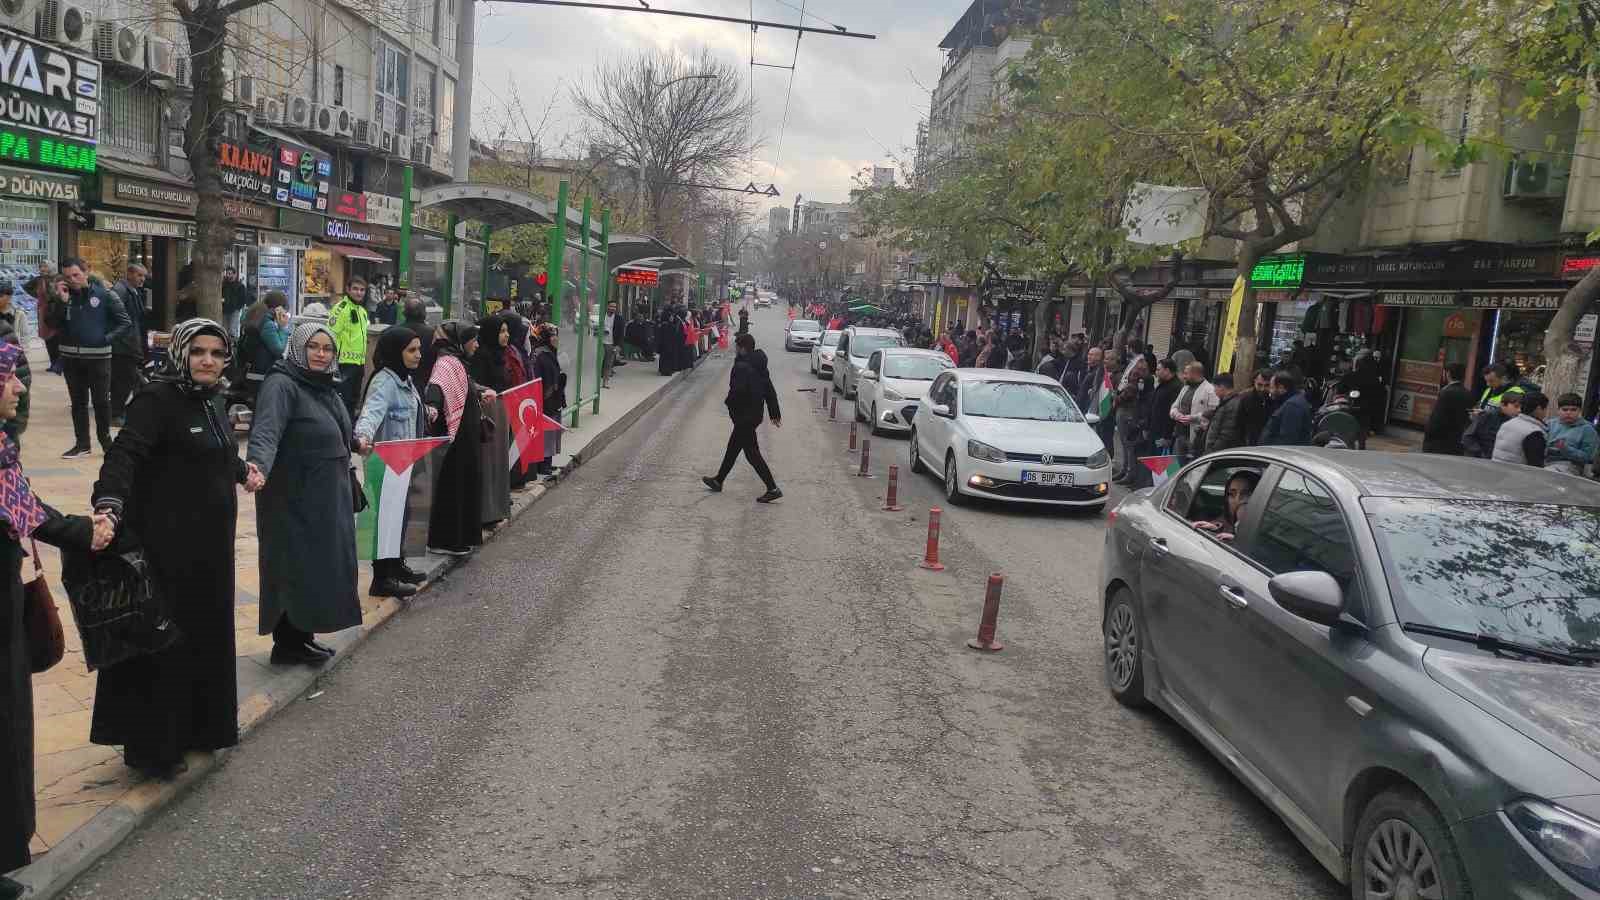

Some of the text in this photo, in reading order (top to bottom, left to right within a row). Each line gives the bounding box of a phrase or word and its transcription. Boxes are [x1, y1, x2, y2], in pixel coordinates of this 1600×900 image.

[11, 175, 79, 200] DÜNYASI
[327, 219, 350, 240] GÜÇLÜ
[1472, 294, 1559, 308] B&E PARFÜM
